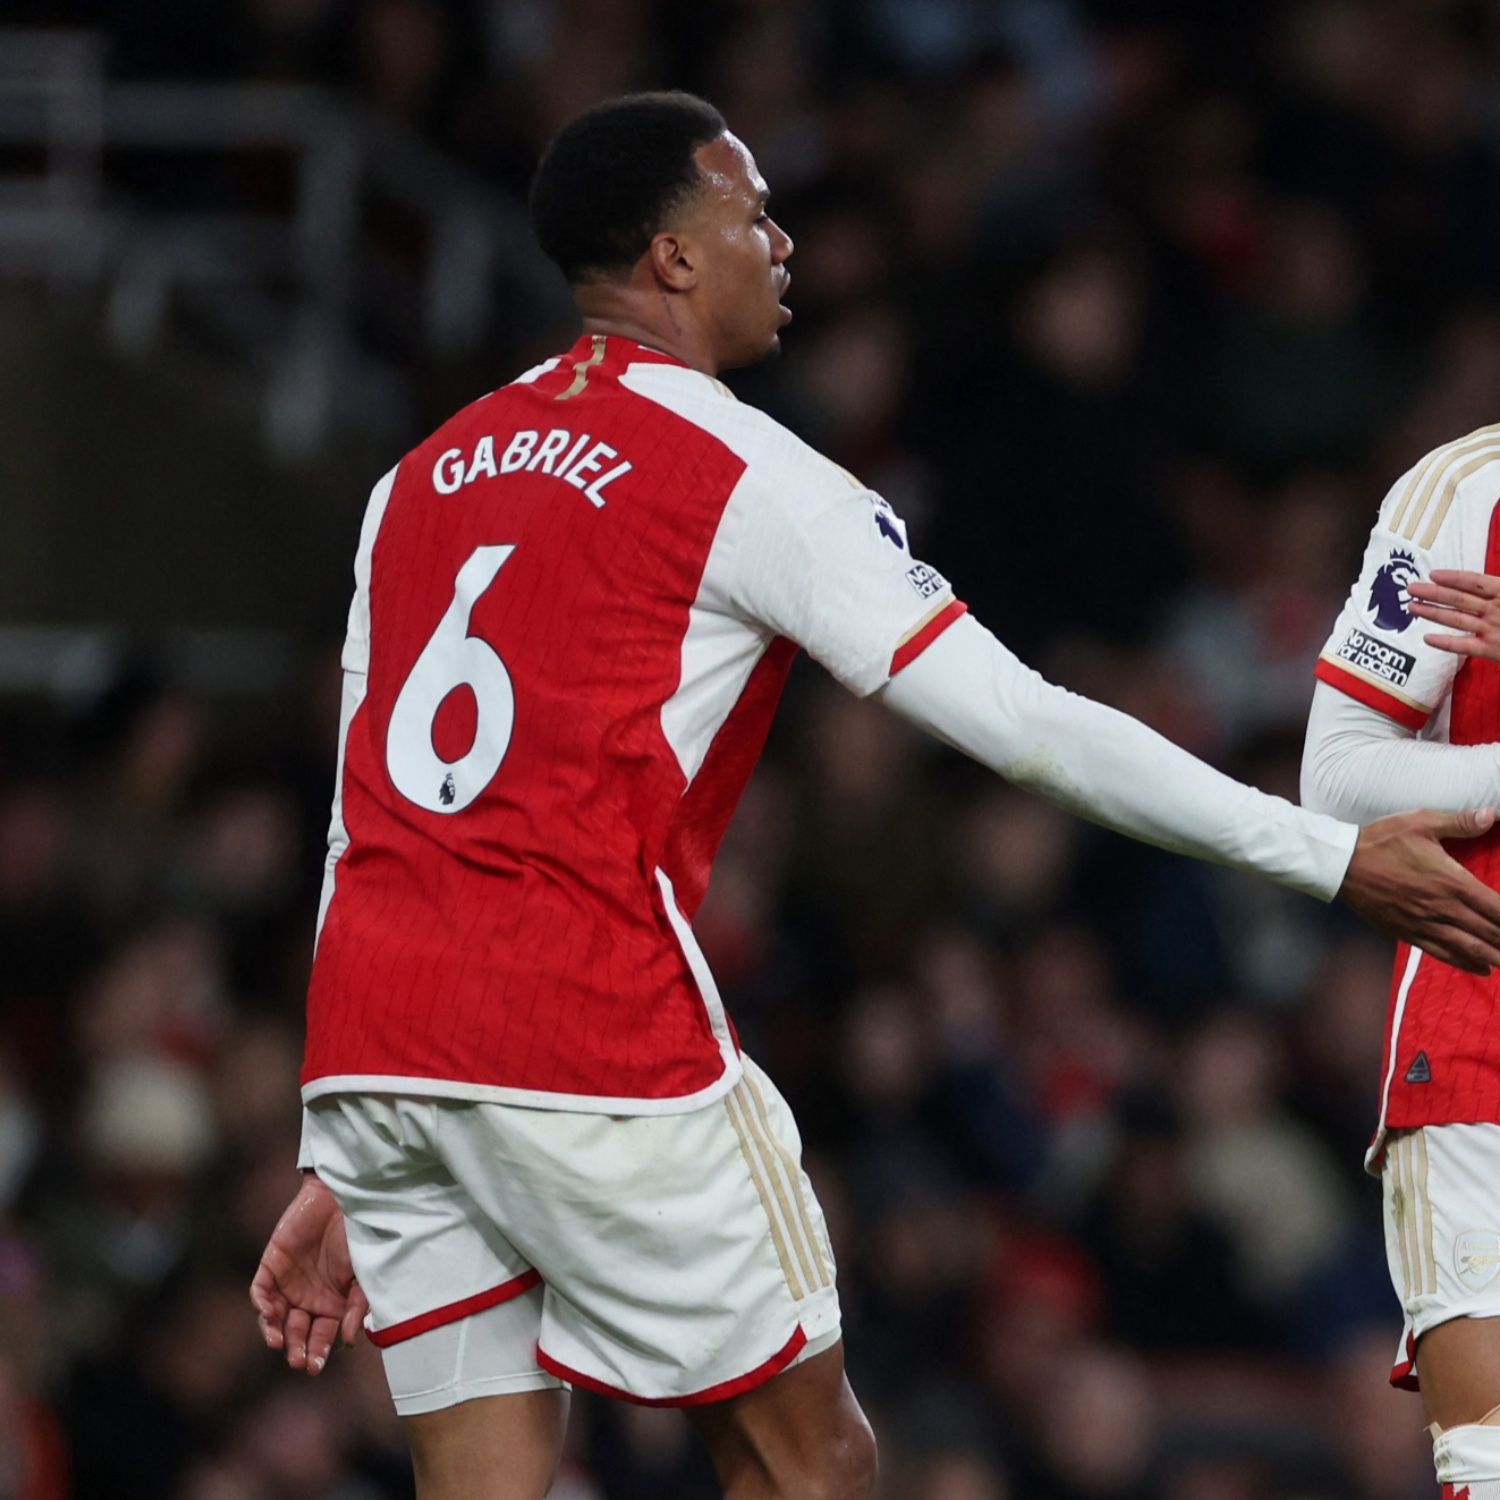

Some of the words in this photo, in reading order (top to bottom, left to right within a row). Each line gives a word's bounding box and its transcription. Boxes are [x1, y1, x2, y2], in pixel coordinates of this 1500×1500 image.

[432, 428, 632, 508] GABRIEL
[385, 543, 516, 814] 6
[1354, 651, 1408, 688] racism
[1362, 639, 1406, 670] room
